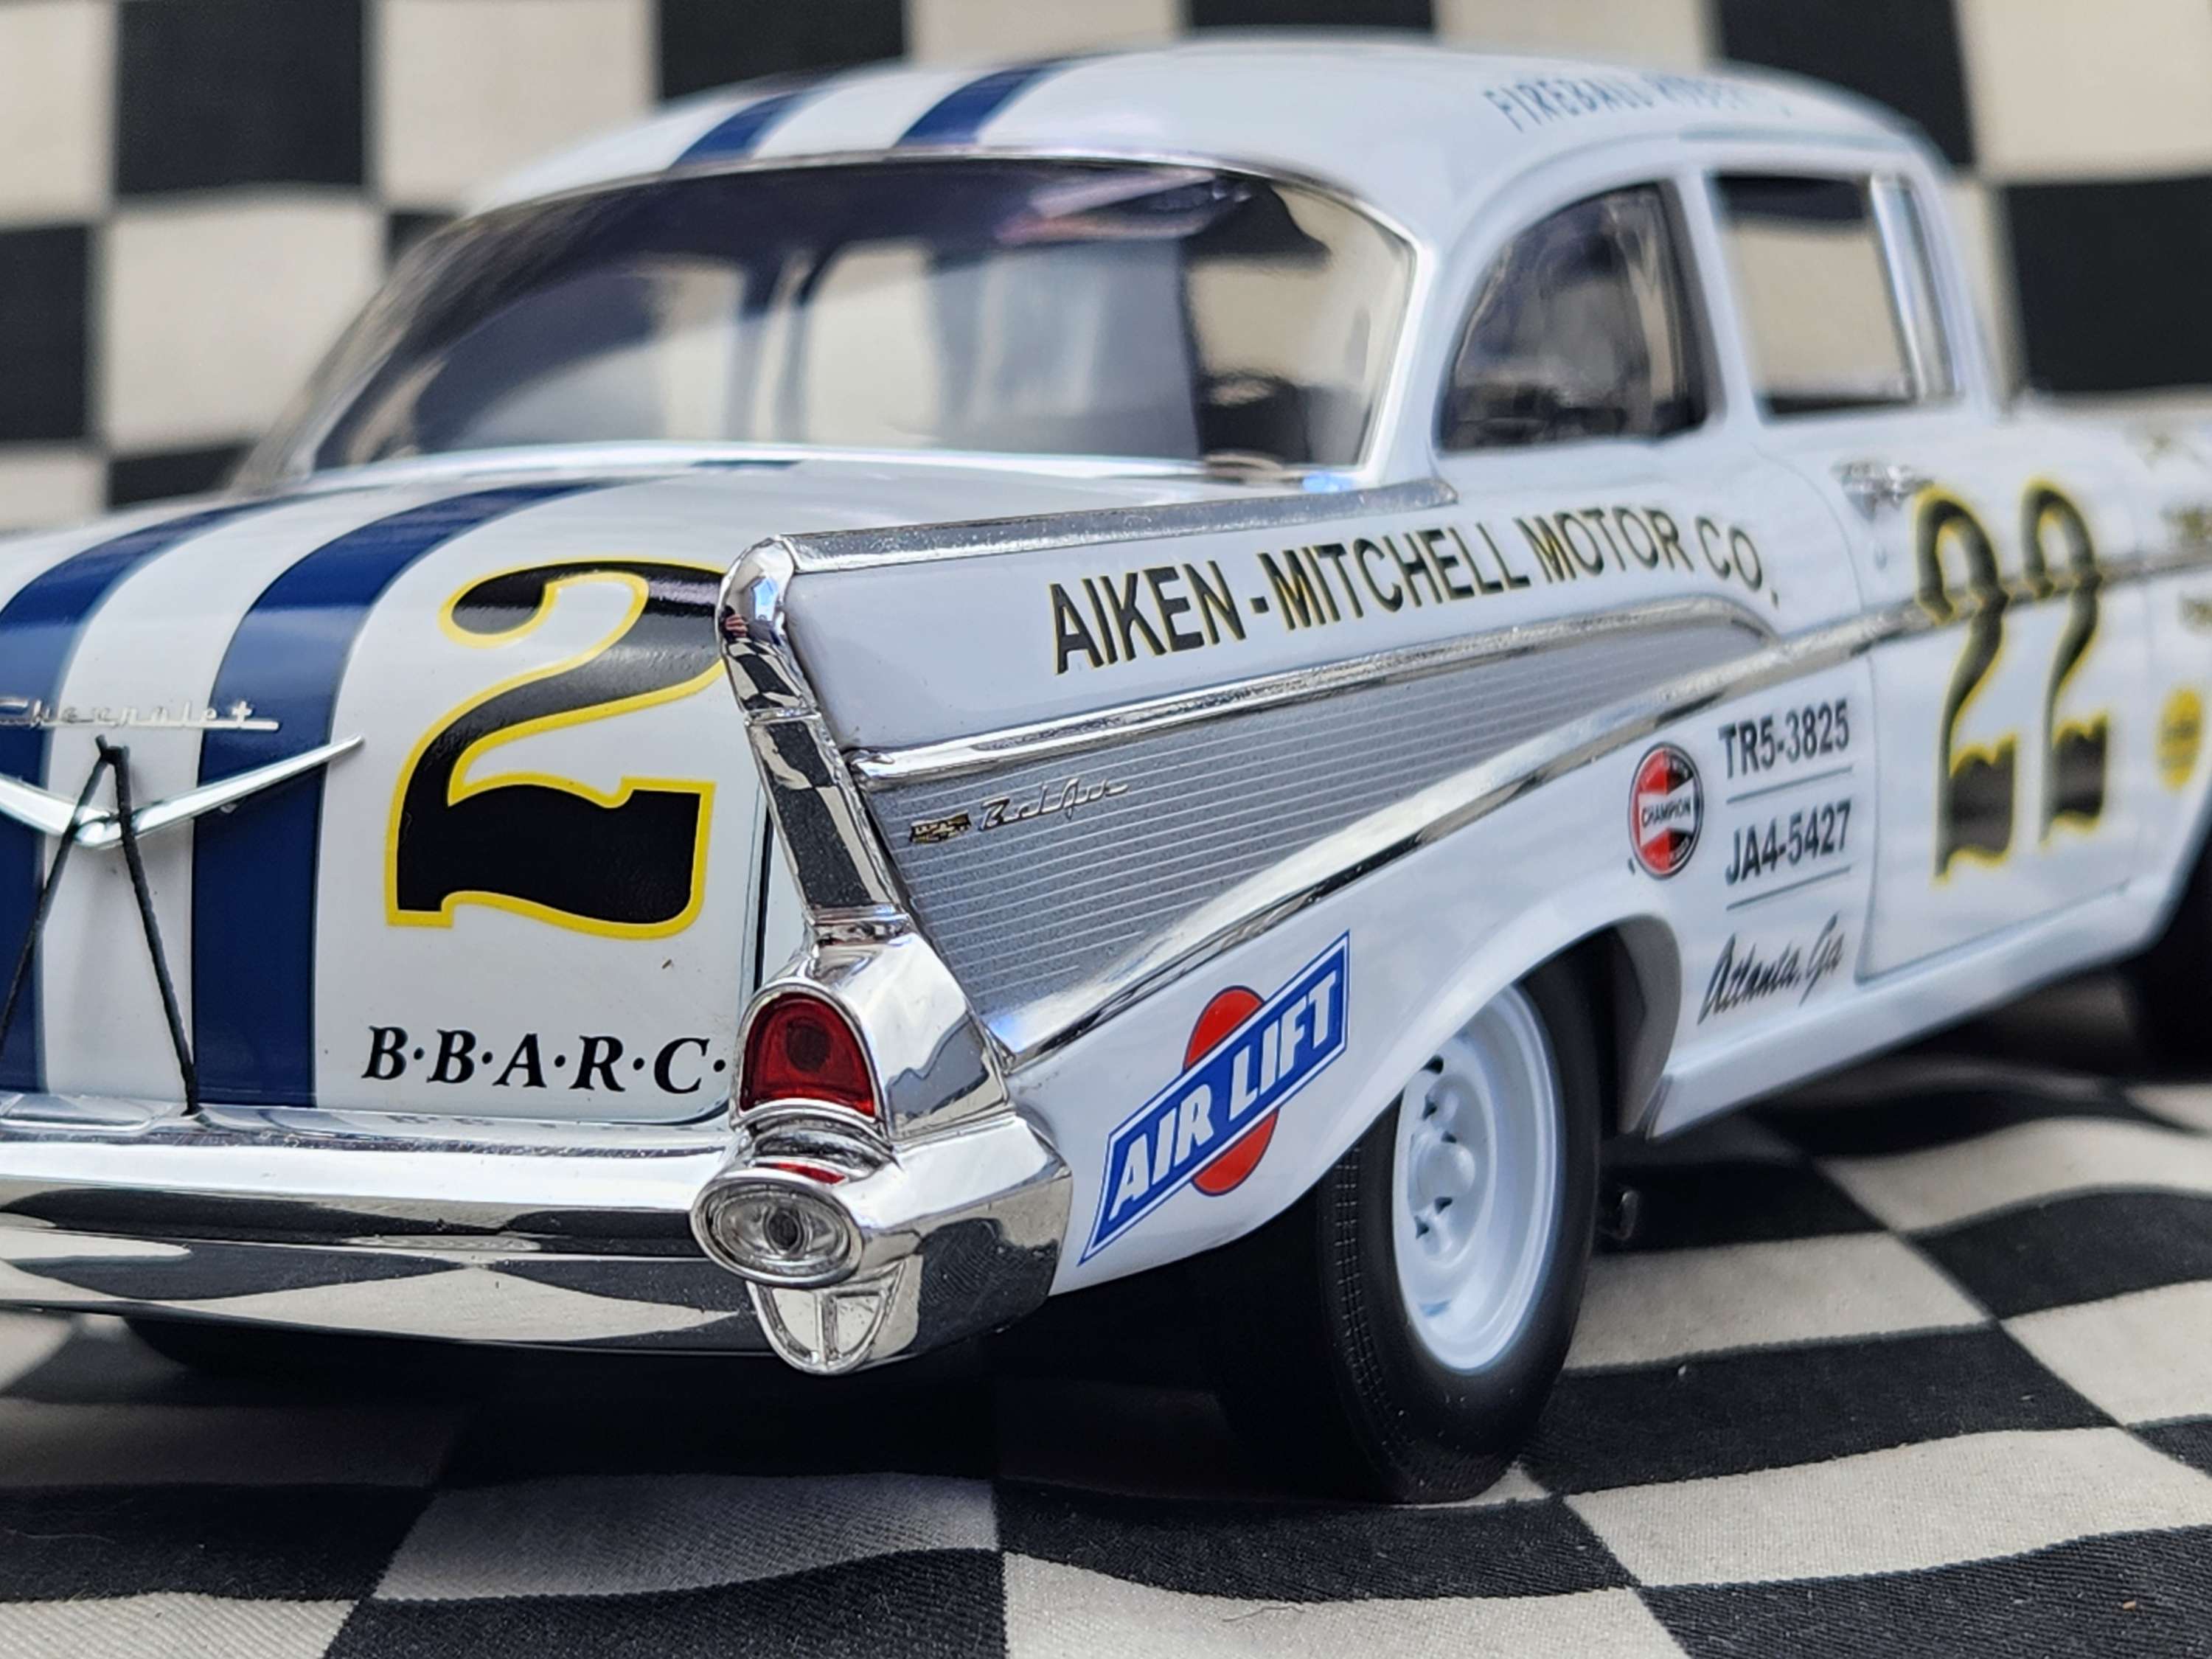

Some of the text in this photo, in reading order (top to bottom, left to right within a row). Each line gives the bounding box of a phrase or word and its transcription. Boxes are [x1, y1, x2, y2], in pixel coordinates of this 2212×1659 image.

[1520, 506, 1692, 584] MOTOR
[385, 557, 724, 942] 2
[1718, 698, 1849, 779] TR5-3825
[1915, 476, 2107, 886] 22
[1725, 799, 1851, 886] JA4-5427
[1109, 970, 1337, 1221] AIR LIFT
